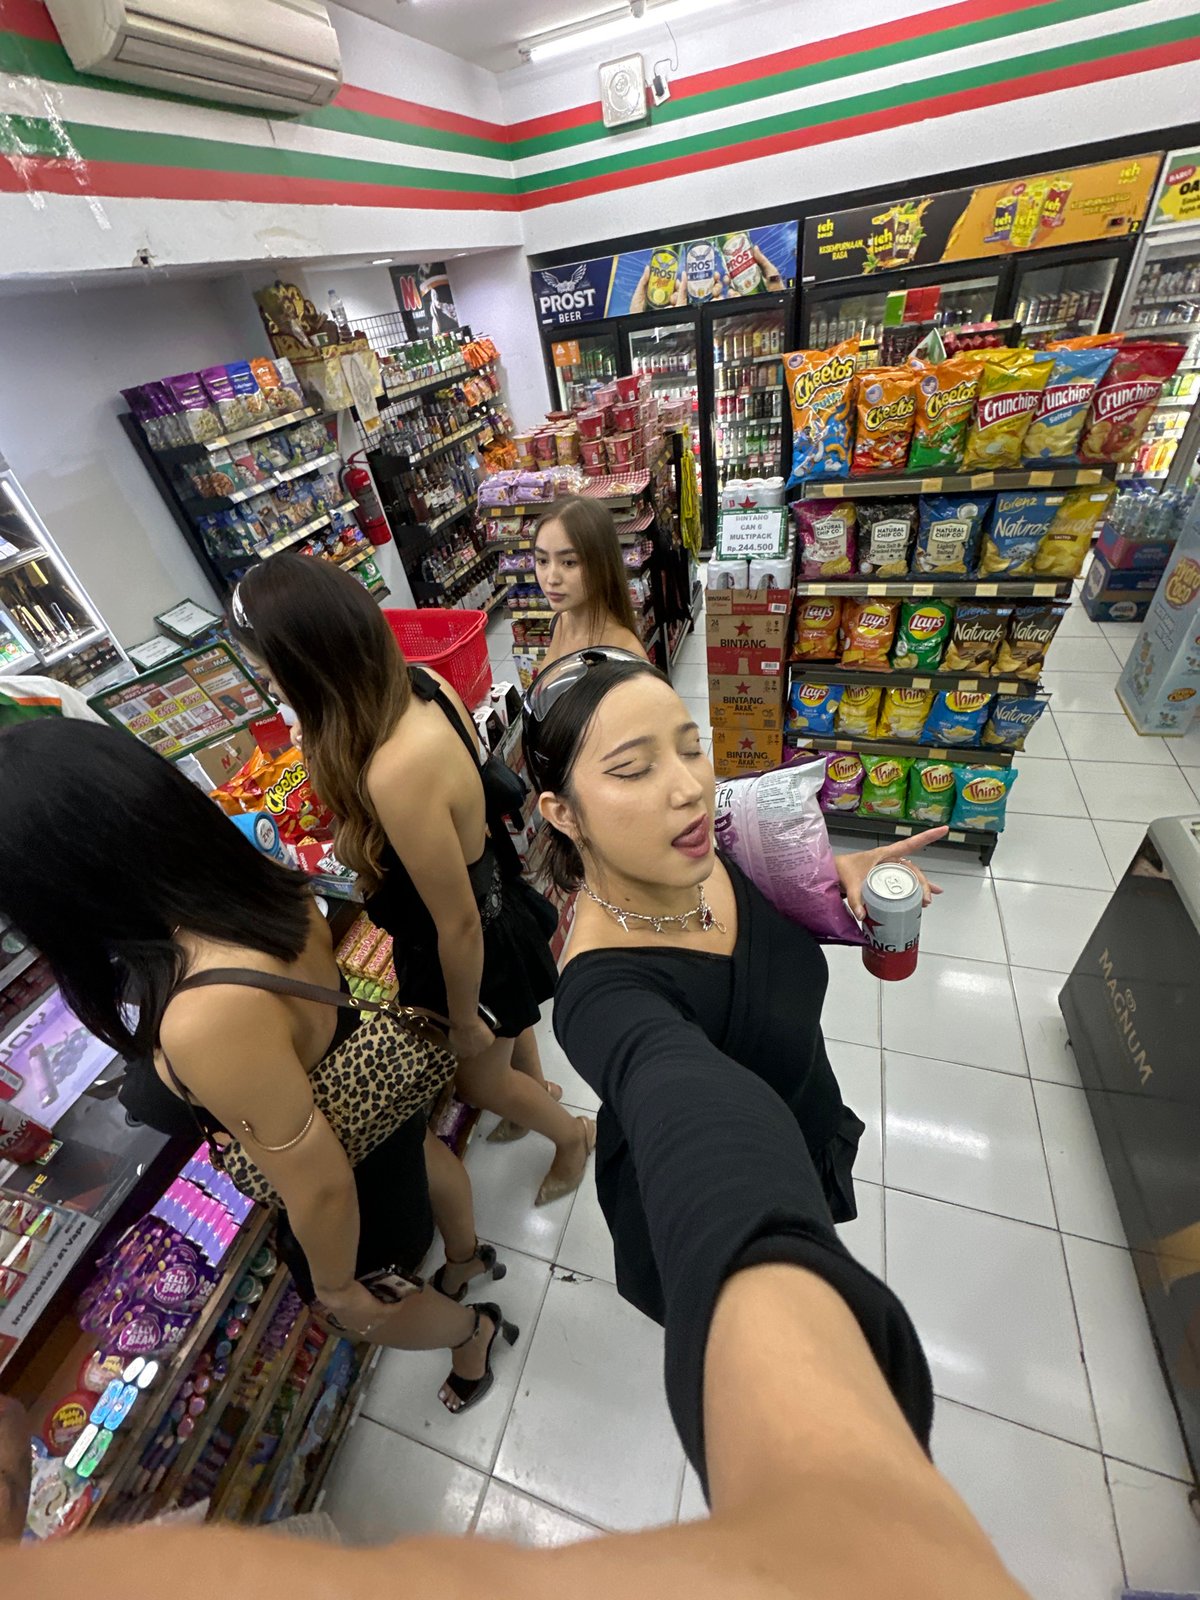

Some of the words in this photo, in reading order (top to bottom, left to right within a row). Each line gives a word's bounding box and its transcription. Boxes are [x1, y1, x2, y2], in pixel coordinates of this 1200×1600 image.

[540, 289, 596, 314] PROST
[558, 311, 582, 324] BEER
[795, 357, 854, 408] Cheetos
[926, 381, 979, 420] Cheetos
[984, 392, 1038, 422] Crunchips
[1098, 383, 1160, 416] Crunchips
[866, 396, 916, 431] Cheetos
[729, 532, 774, 541] MULTIPACK
[740, 523, 757, 531] CAN
[936, 526, 965, 534] NATURAL
[720, 638, 767, 649] BINTANG
[723, 696, 767, 705] BINTANG
[726, 751, 774, 760] BINTANG
[829, 759, 860, 779] Thins
[922, 768, 953, 787] Thins
[266, 765, 309, 814] Cheetos
[966, 780, 1002, 799] Thins
[1099, 947, 1154, 1085] MAGNUM
[12, 1262, 60, 1325] Indonesia's
[65, 1221, 87, 1247] Vape
[160, 1272, 190, 1285] JELLY
[162, 1282, 191, 1295] BEAN
[126, 1335, 156, 1347] BEAN
